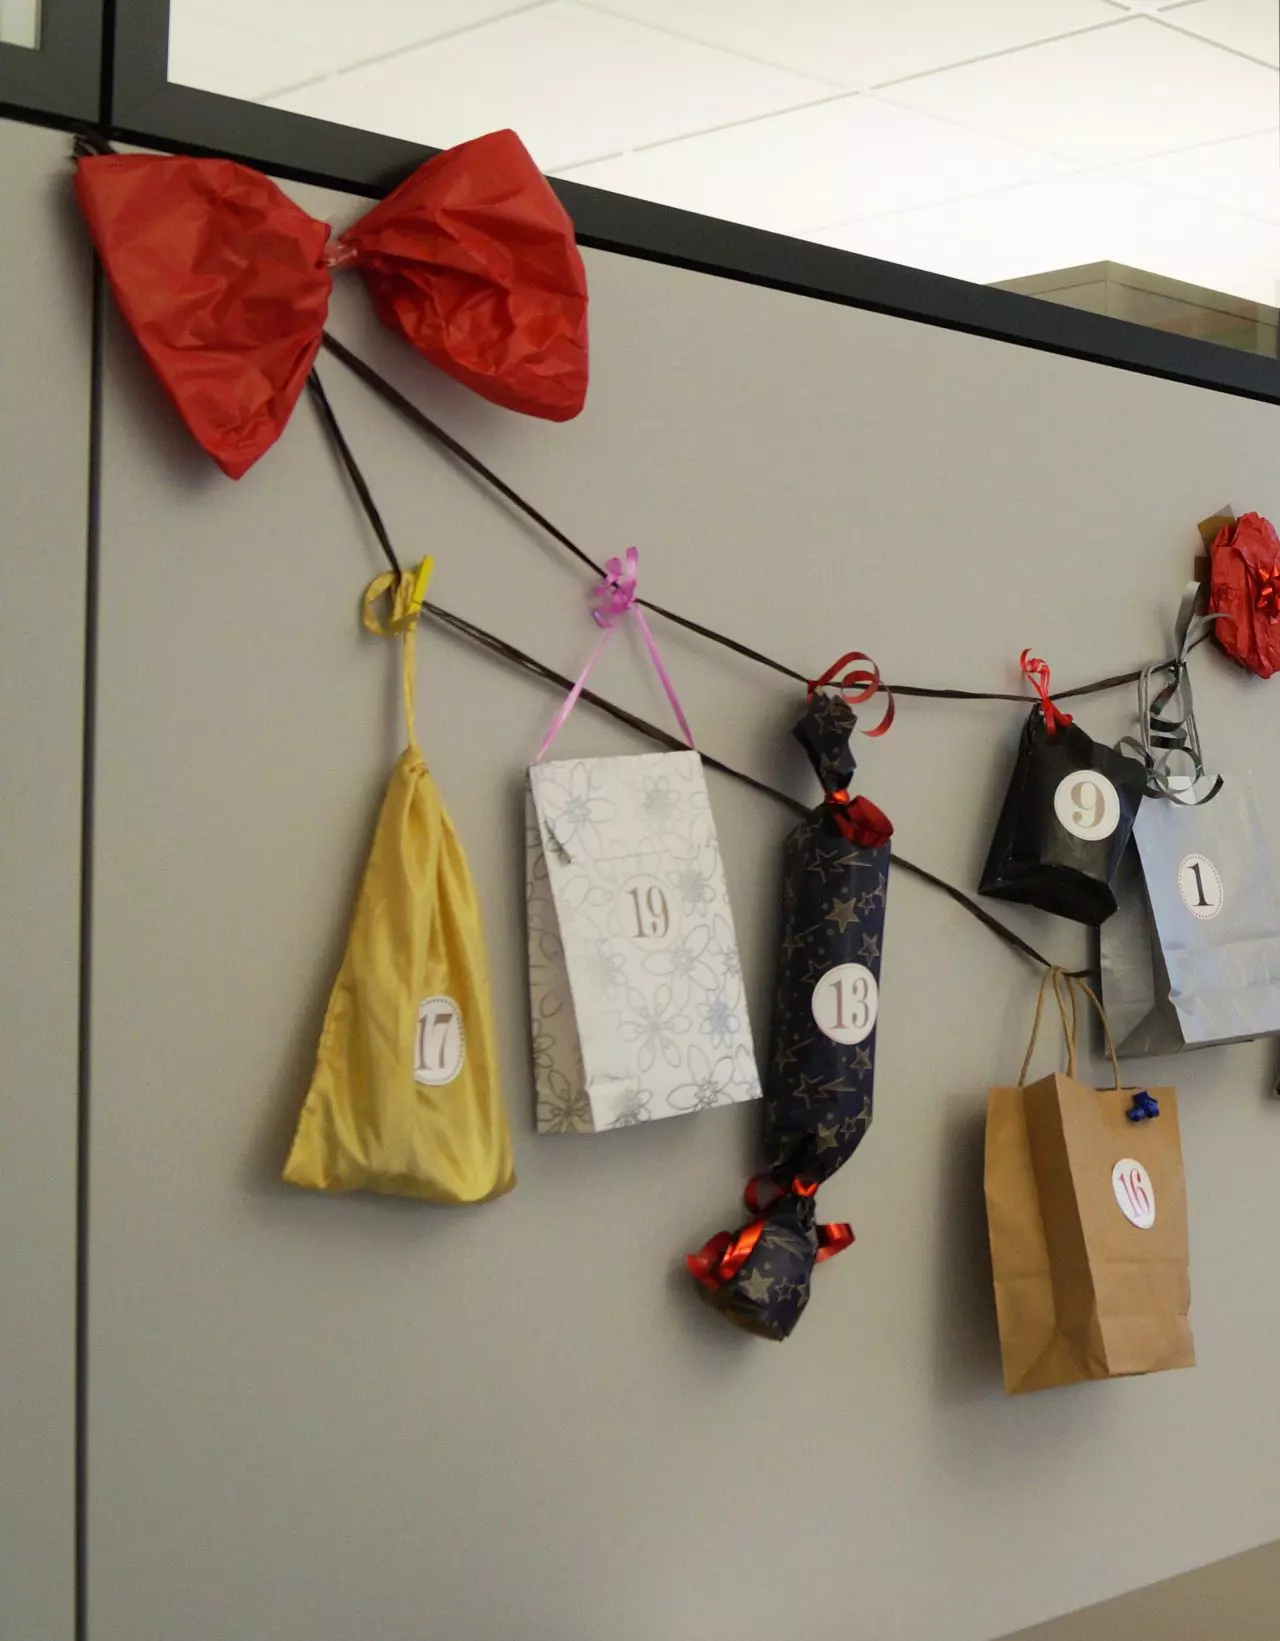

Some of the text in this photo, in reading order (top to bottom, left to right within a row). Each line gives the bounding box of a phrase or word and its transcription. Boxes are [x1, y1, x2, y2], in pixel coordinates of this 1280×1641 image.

[1070, 781, 1105, 829] 9
[1187, 862, 1214, 907] 1
[626, 885, 670, 939] 19
[827, 977, 869, 1030] 13
[414, 1012, 453, 1071] 17
[1118, 1167, 1151, 1218] 16
